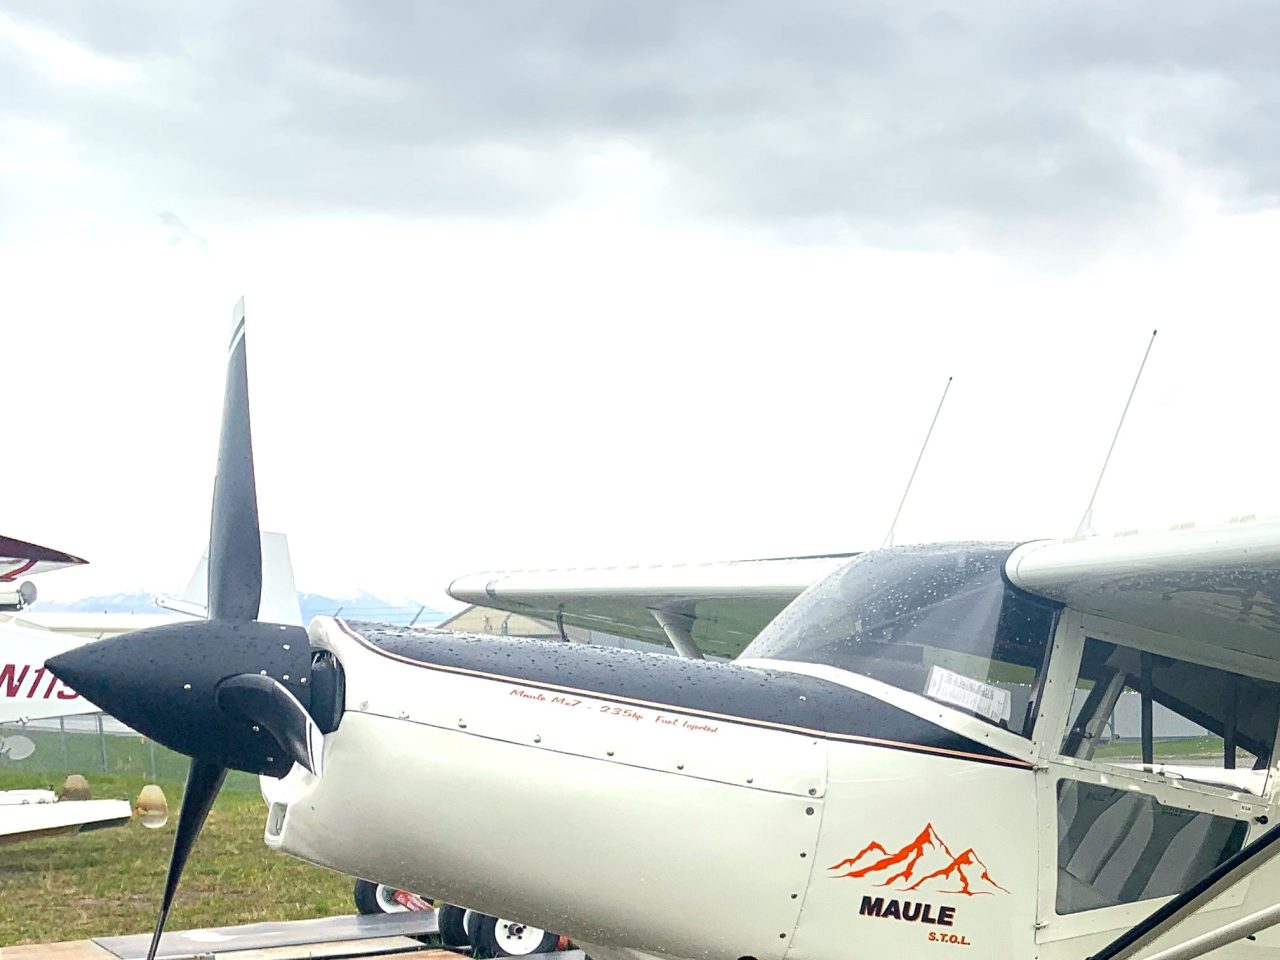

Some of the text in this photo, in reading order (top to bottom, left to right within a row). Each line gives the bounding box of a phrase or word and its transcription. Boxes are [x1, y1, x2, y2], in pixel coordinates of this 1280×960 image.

[600, 705, 644, 721] 235hp
[655, 715, 679, 726] Fuel
[859, 895, 957, 927] MAULE
[928, 932, 971, 946] S.T.O.L.
